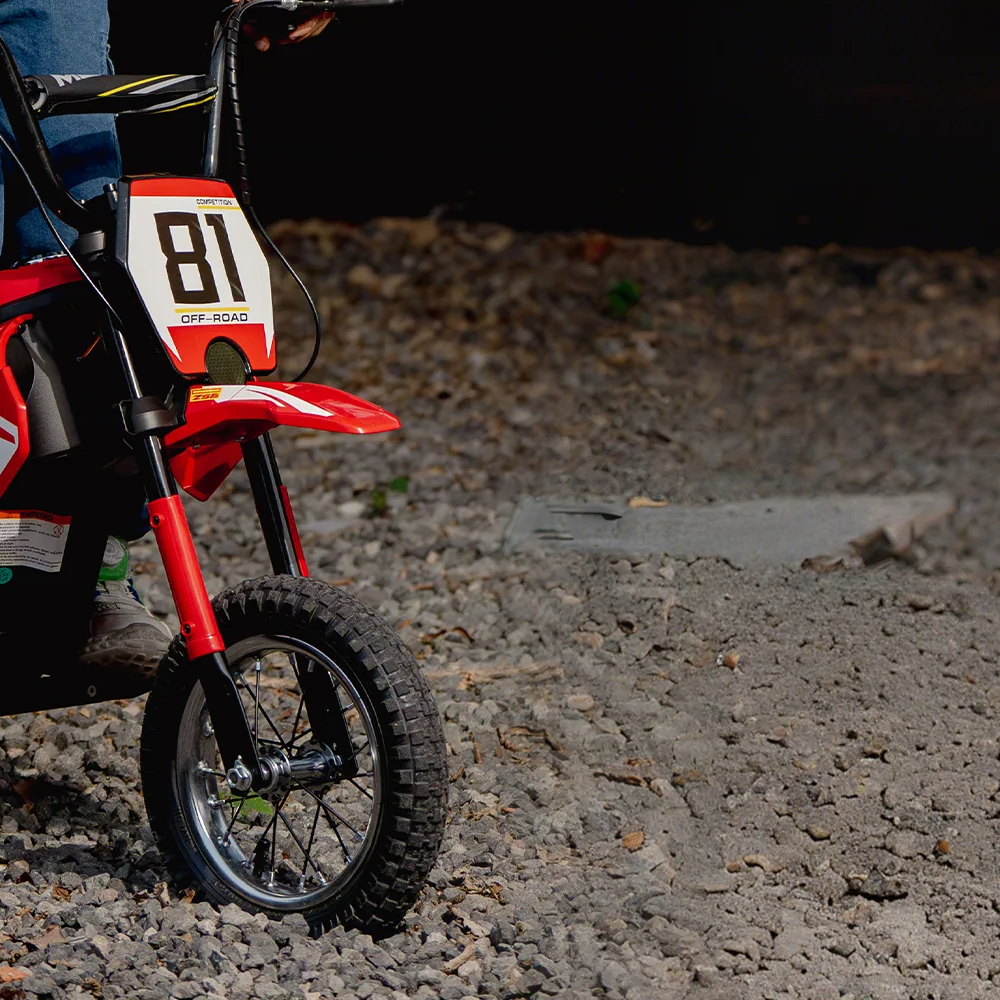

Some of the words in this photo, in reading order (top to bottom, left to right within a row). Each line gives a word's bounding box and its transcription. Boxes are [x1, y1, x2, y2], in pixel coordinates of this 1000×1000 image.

[196, 198, 232, 206] COMPETITION
[153, 211, 247, 305] 81
[181, 312, 248, 324] OFF-ROAD
